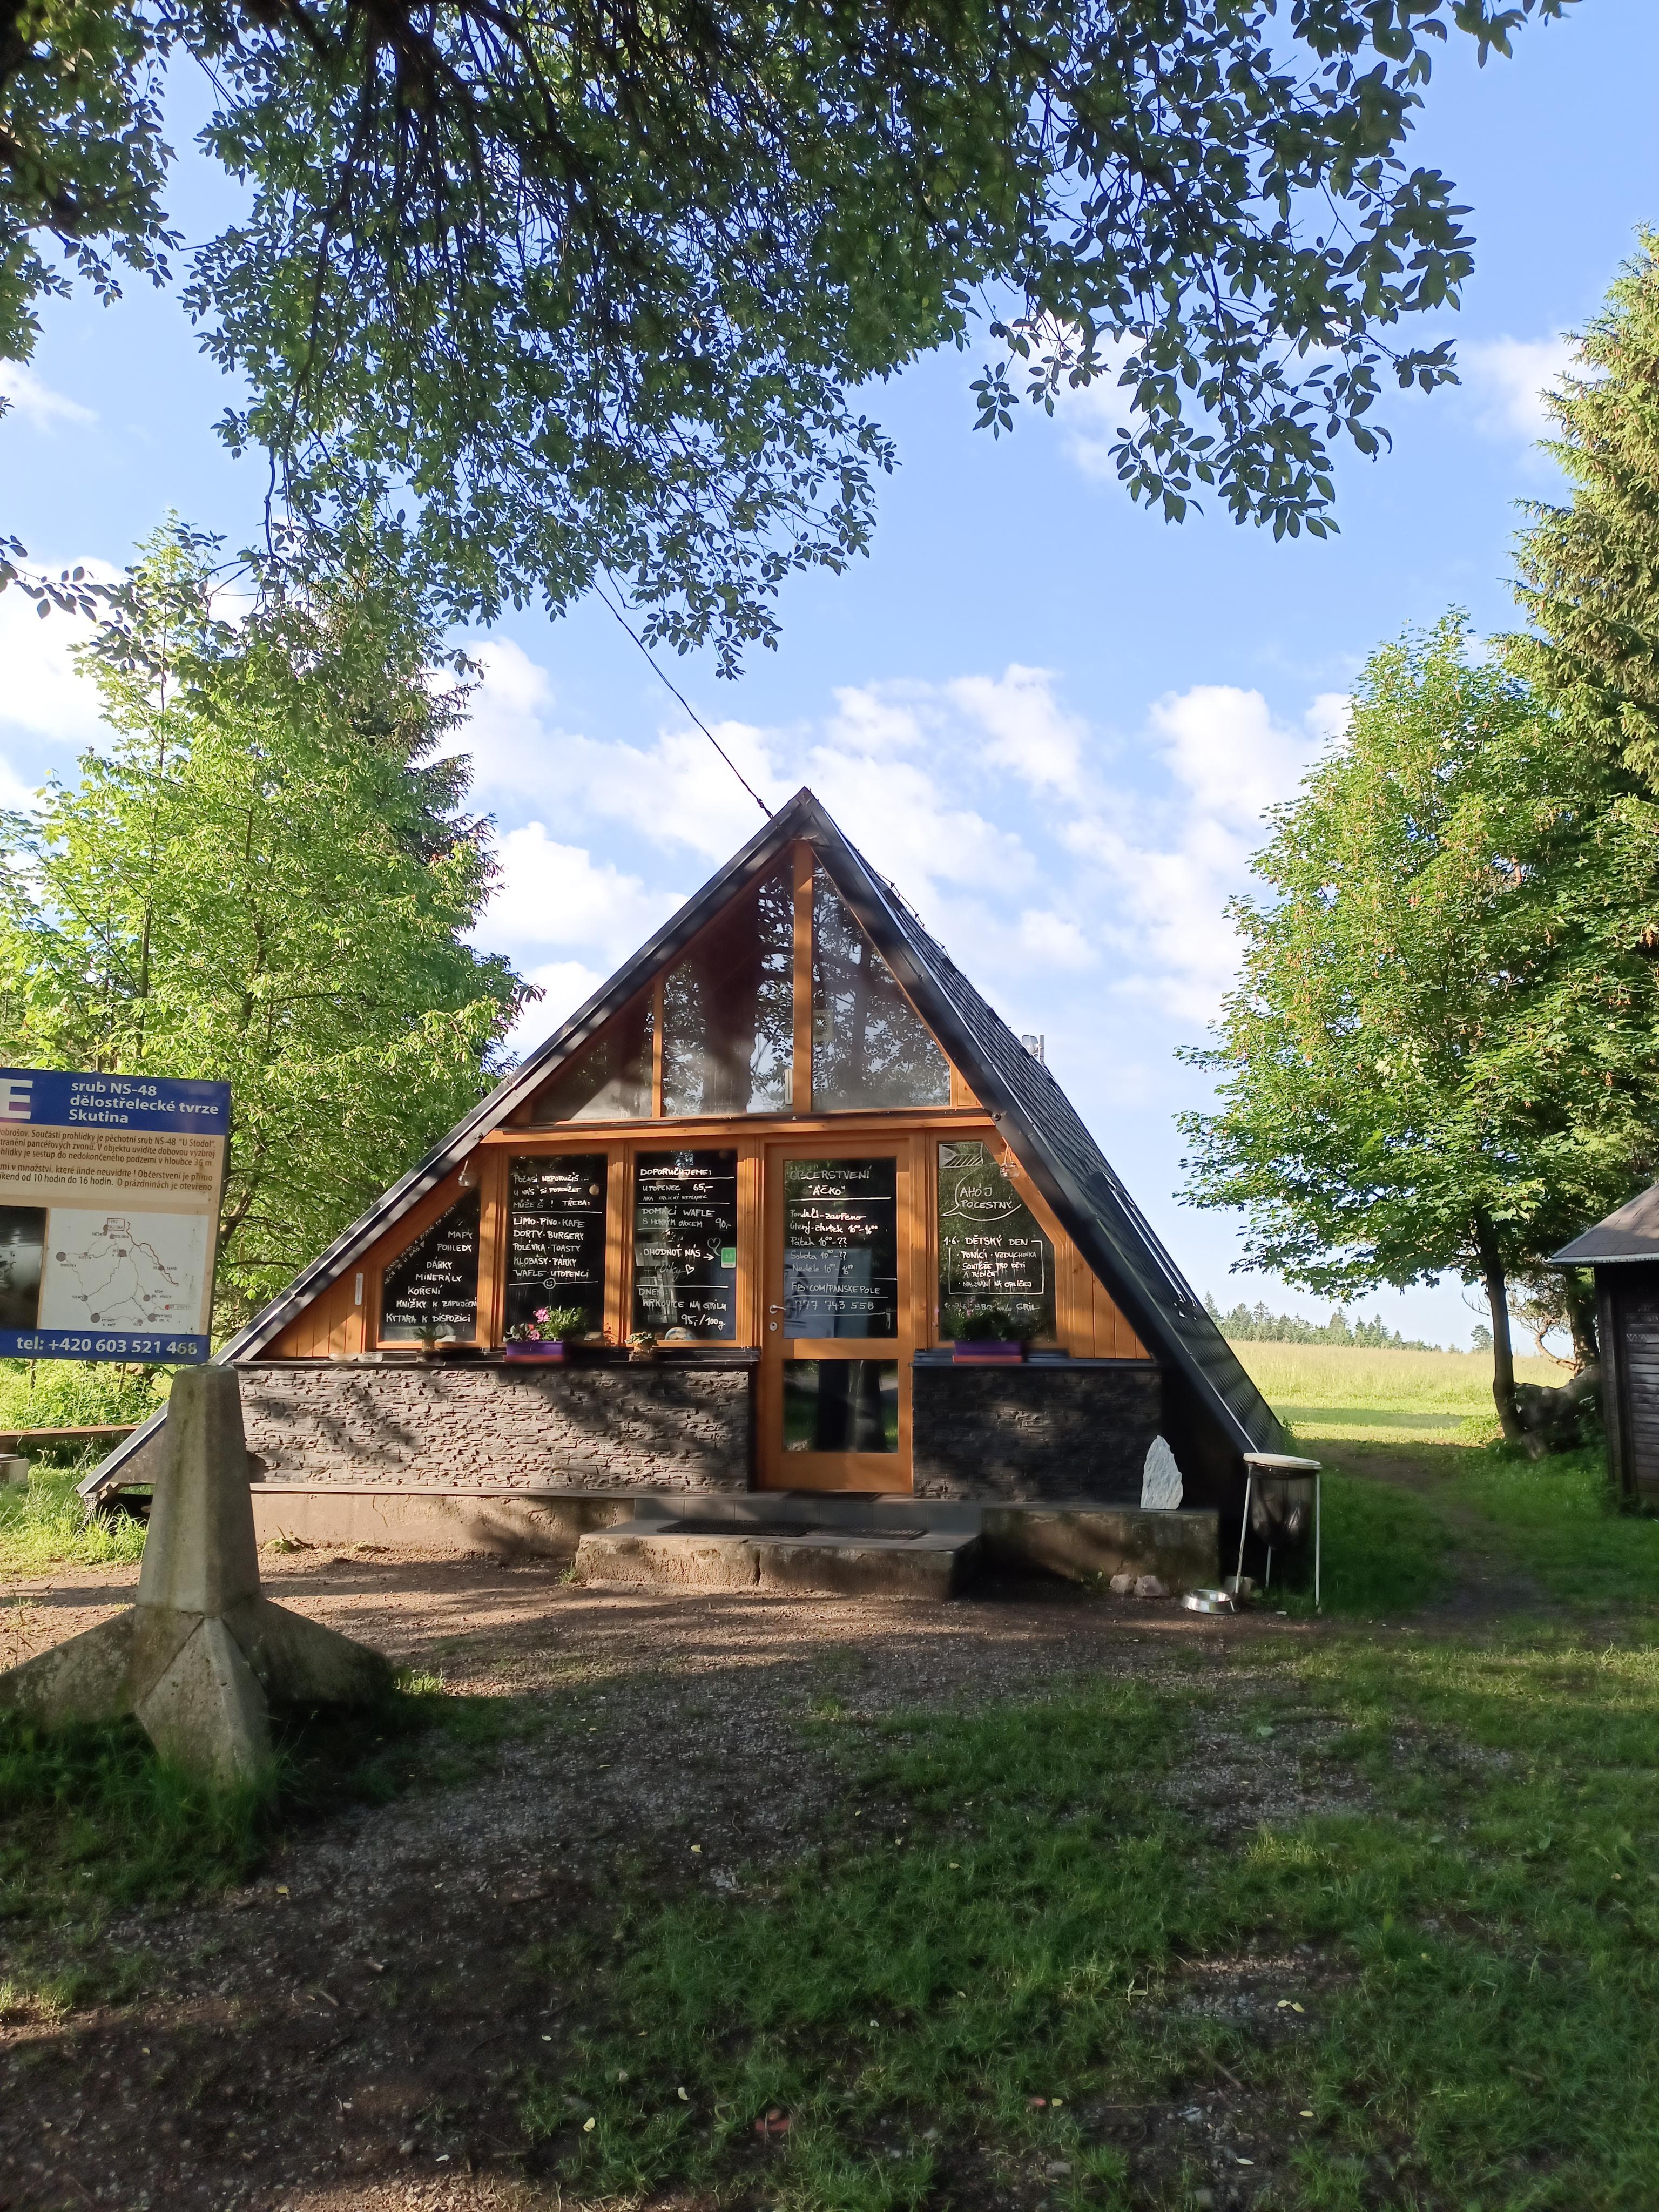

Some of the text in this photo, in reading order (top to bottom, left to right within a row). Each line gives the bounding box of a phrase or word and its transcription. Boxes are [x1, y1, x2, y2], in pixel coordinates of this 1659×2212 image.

[71, 1082, 157, 1096] srub NS-48
[70, 1095, 219, 1115] dělostřelecké tvrze
[69, 1109, 128, 1123] Skutina
[0, 1128, 29, 1137] obrošov.
[32, 1129, 61, 1139] Součástí
[96, 1134, 103, 1143] je
[105, 1134, 136, 1143] pěchotní
[138, 1136, 153, 1144] srub
[155, 1137, 176, 1145] NS-48
[104, 1144, 130, 1154] objektu
[132, 1146, 156, 1154] uvidíte
[158, 1147, 188, 1156] dobovou
[24, 1150, 30, 1158] je
[32, 1150, 55, 1159] sestup
[57, 1151, 66, 1159] do
[69, 1152, 124, 1162] nedokončeného
[126, 1156, 157, 1164] podzemí
[165, 1157, 192, 1165] hloubce
[56, 1165, 74, 1174] které
[138, 1170, 180, 1179] Občerstvení
[183, 1173, 189, 1181] je
[22, 1173, 31, 1181] od
[34, 1174, 42, 1182] 10
[44, 1174, 65, 1183] hodin
[79, 1176, 88, 1184] 16
[90, 1177, 114, 1186] hodin.
[124, 1179, 169, 1189] prázdninách
[522, 1187, 535, 1196] NÁS
[683, 1209, 716, 1217] WAFLE
[562, 1218, 585, 1228] KAFE
[678, 1220, 703, 1228] OVOCEM
[448, 1231, 473, 1239] MAPY
[513, 1229, 584, 1241] DORTY BURGERY
[965, 1235, 1002, 1246] DĚTSKÝ
[1008, 1238, 1028, 1246] DEN
[437, 1244, 472, 1252] POHLEDY
[551, 1244, 581, 1252] TOASTY
[685, 1244, 701, 1257] NÁS
[552, 1254, 577, 1267] PÁRKY
[790, 1250, 817, 1260] Sobota
[426, 1256, 453, 1270] DÁRKY
[408, 1284, 443, 1296] KOŘENÍ
[690, 1300, 701, 1310] NA
[795, 1300, 874, 1311] 777 743 558
[1016, 1302, 1040, 1311] GRIL
[386, 1313, 417, 1324] KYTARA
[422, 1315, 428, 1323] K
[17, 1336, 198, 1354] tel: +420 603 521 468
